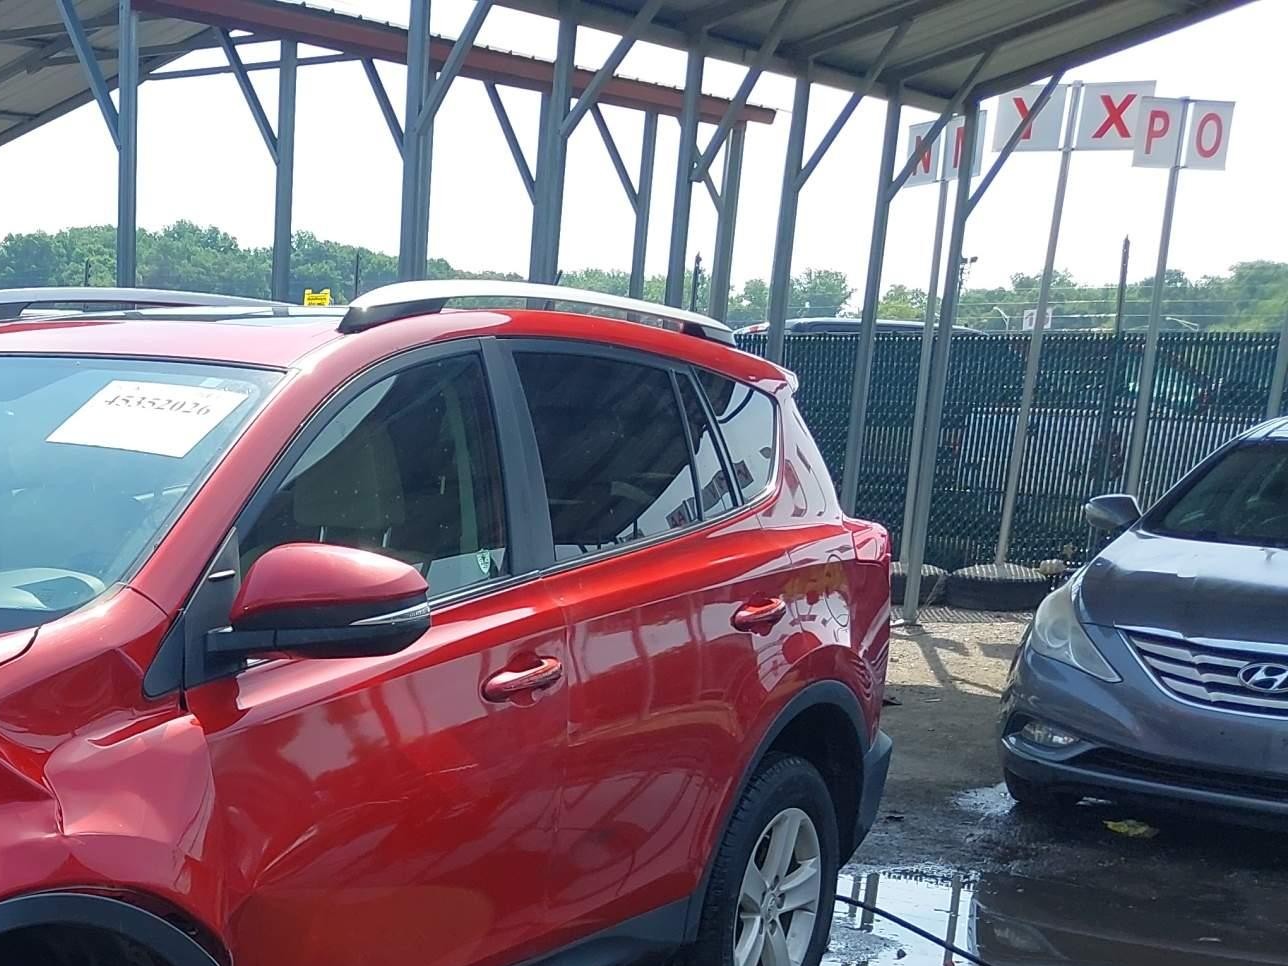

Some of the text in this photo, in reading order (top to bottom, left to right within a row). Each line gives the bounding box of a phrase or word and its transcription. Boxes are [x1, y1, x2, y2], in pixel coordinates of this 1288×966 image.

[1091, 93, 1138, 139] X
[1143, 109, 1224, 159] P O
[104, 394, 211, 416] 45352026
